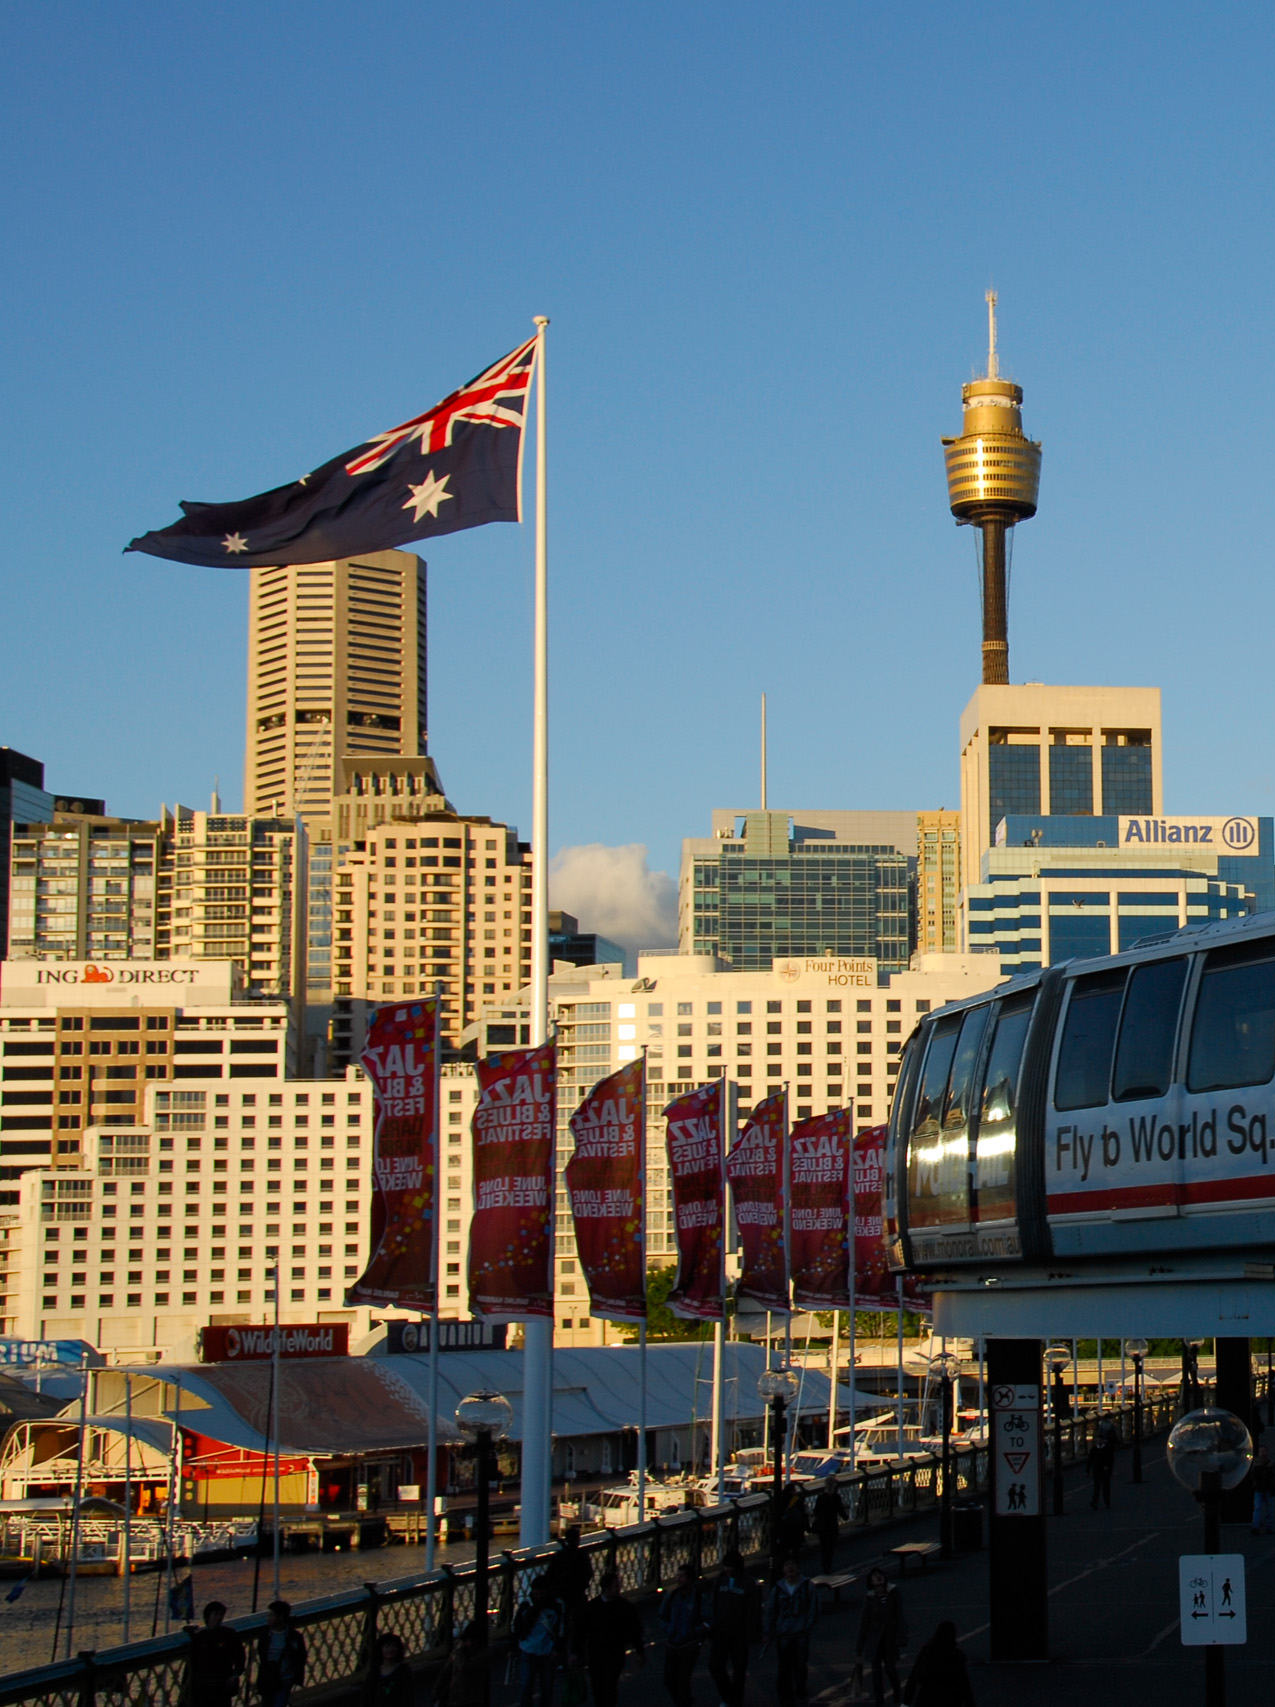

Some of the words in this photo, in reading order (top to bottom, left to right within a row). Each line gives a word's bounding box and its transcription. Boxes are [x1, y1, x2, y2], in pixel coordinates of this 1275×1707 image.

[1125, 819, 1213, 843] Allianz
[805, 959, 835, 972] Four
[838, 959, 873, 972] Points
[37, 969, 78, 984] ING
[119, 969, 200, 984] DIRECT
[828, 974, 872, 986] HOTEL
[1056, 1125, 1093, 1181] Fly
[1128, 1108, 1217, 1162] World
[1226, 1104, 1275, 1165] Sq.
[242, 1328, 334, 1355] WildifeWorld
[420, 1324, 493, 1347] AUARIUM
[1008, 1436, 1024, 1448] TO
